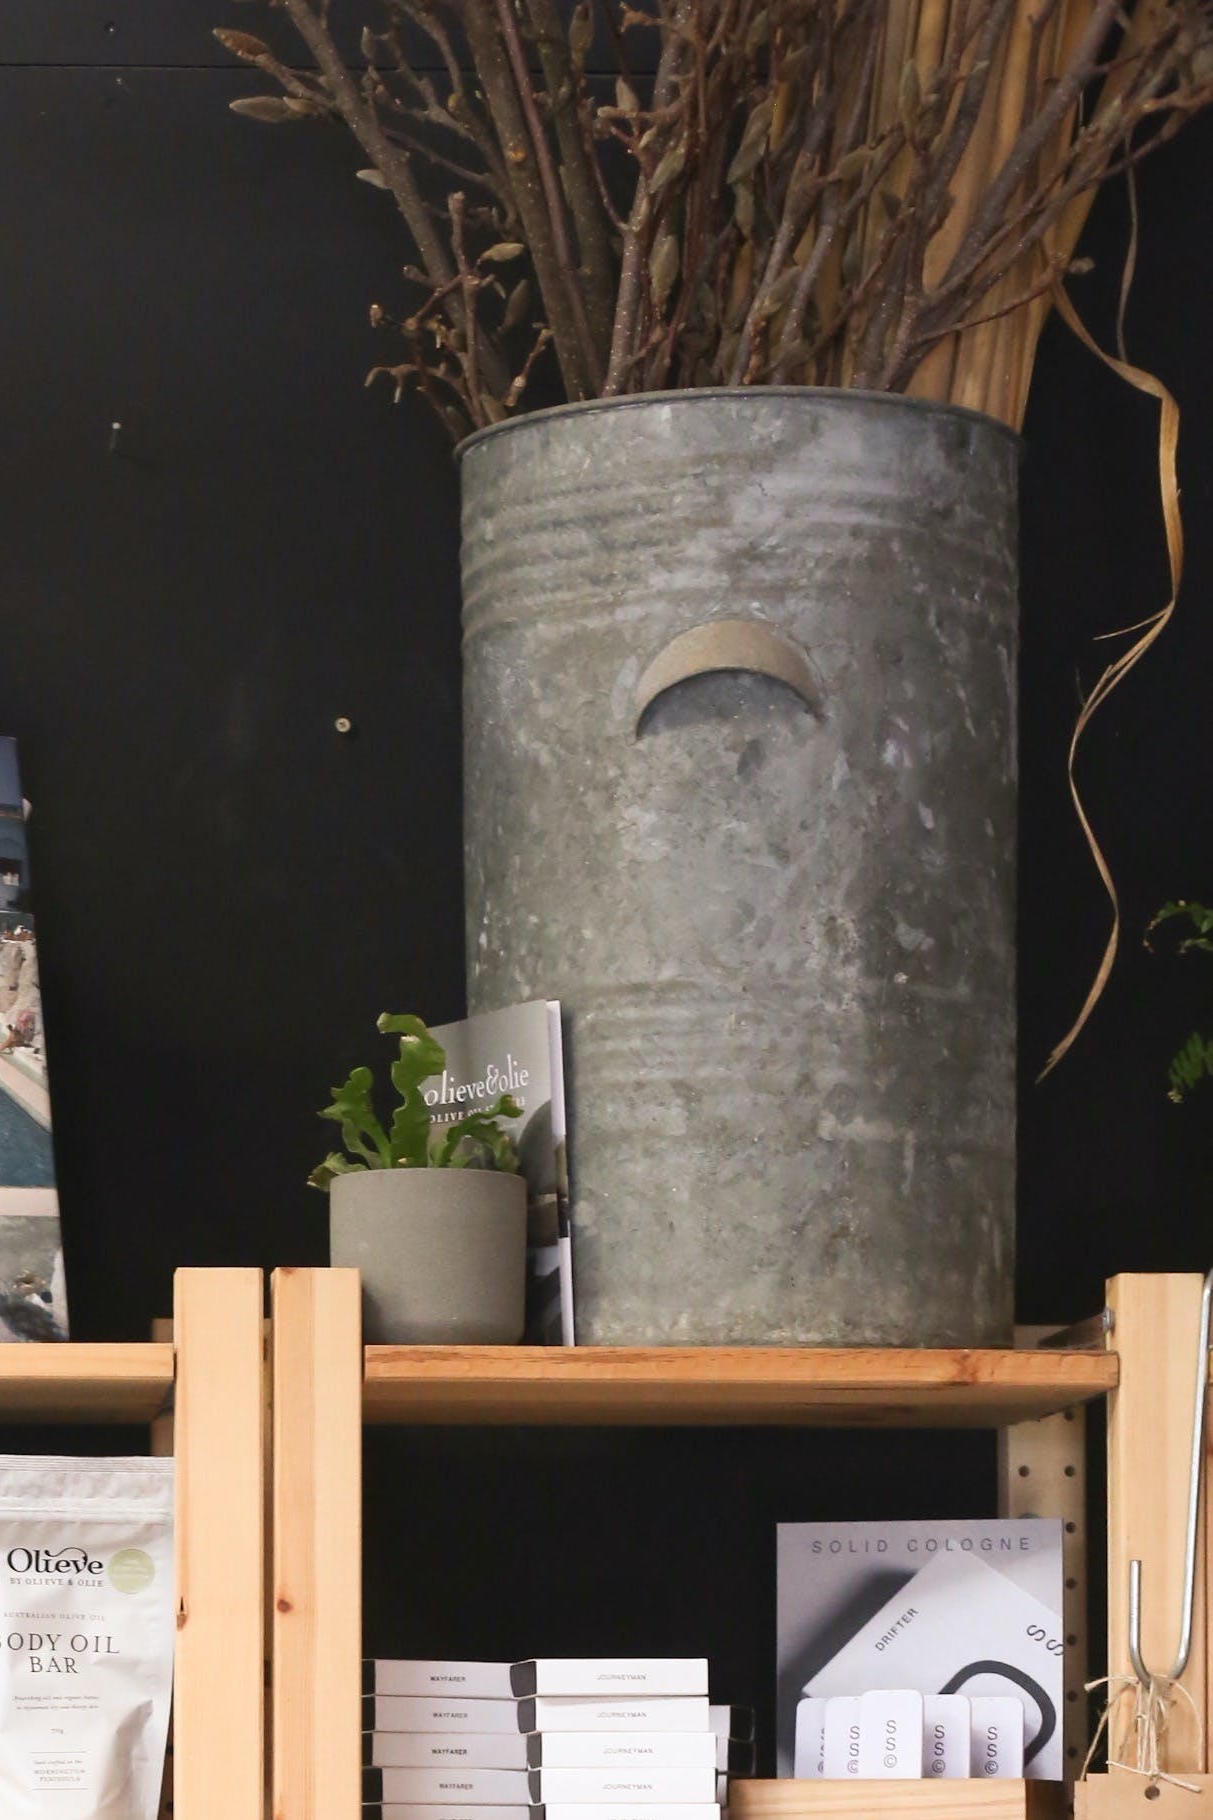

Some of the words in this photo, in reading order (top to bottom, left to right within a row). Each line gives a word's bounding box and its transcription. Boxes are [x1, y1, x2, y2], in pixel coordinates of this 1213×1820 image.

[424, 1054, 529, 1106] olieve&olie
[811, 1539, 888, 1554] SOLID
[907, 1537, 1030, 1552] COLOGNE
[7, 1547, 104, 1574] Olieve
[10, 1577, 21, 1585] BY
[25, 1578, 63, 1586] OLIEVE
[77, 1579, 104, 1587] OLIE
[875, 1608, 919, 1651] DRIFTER
[70, 1634, 120, 1653] OIL
[29, 1656, 79, 1673] BAR
